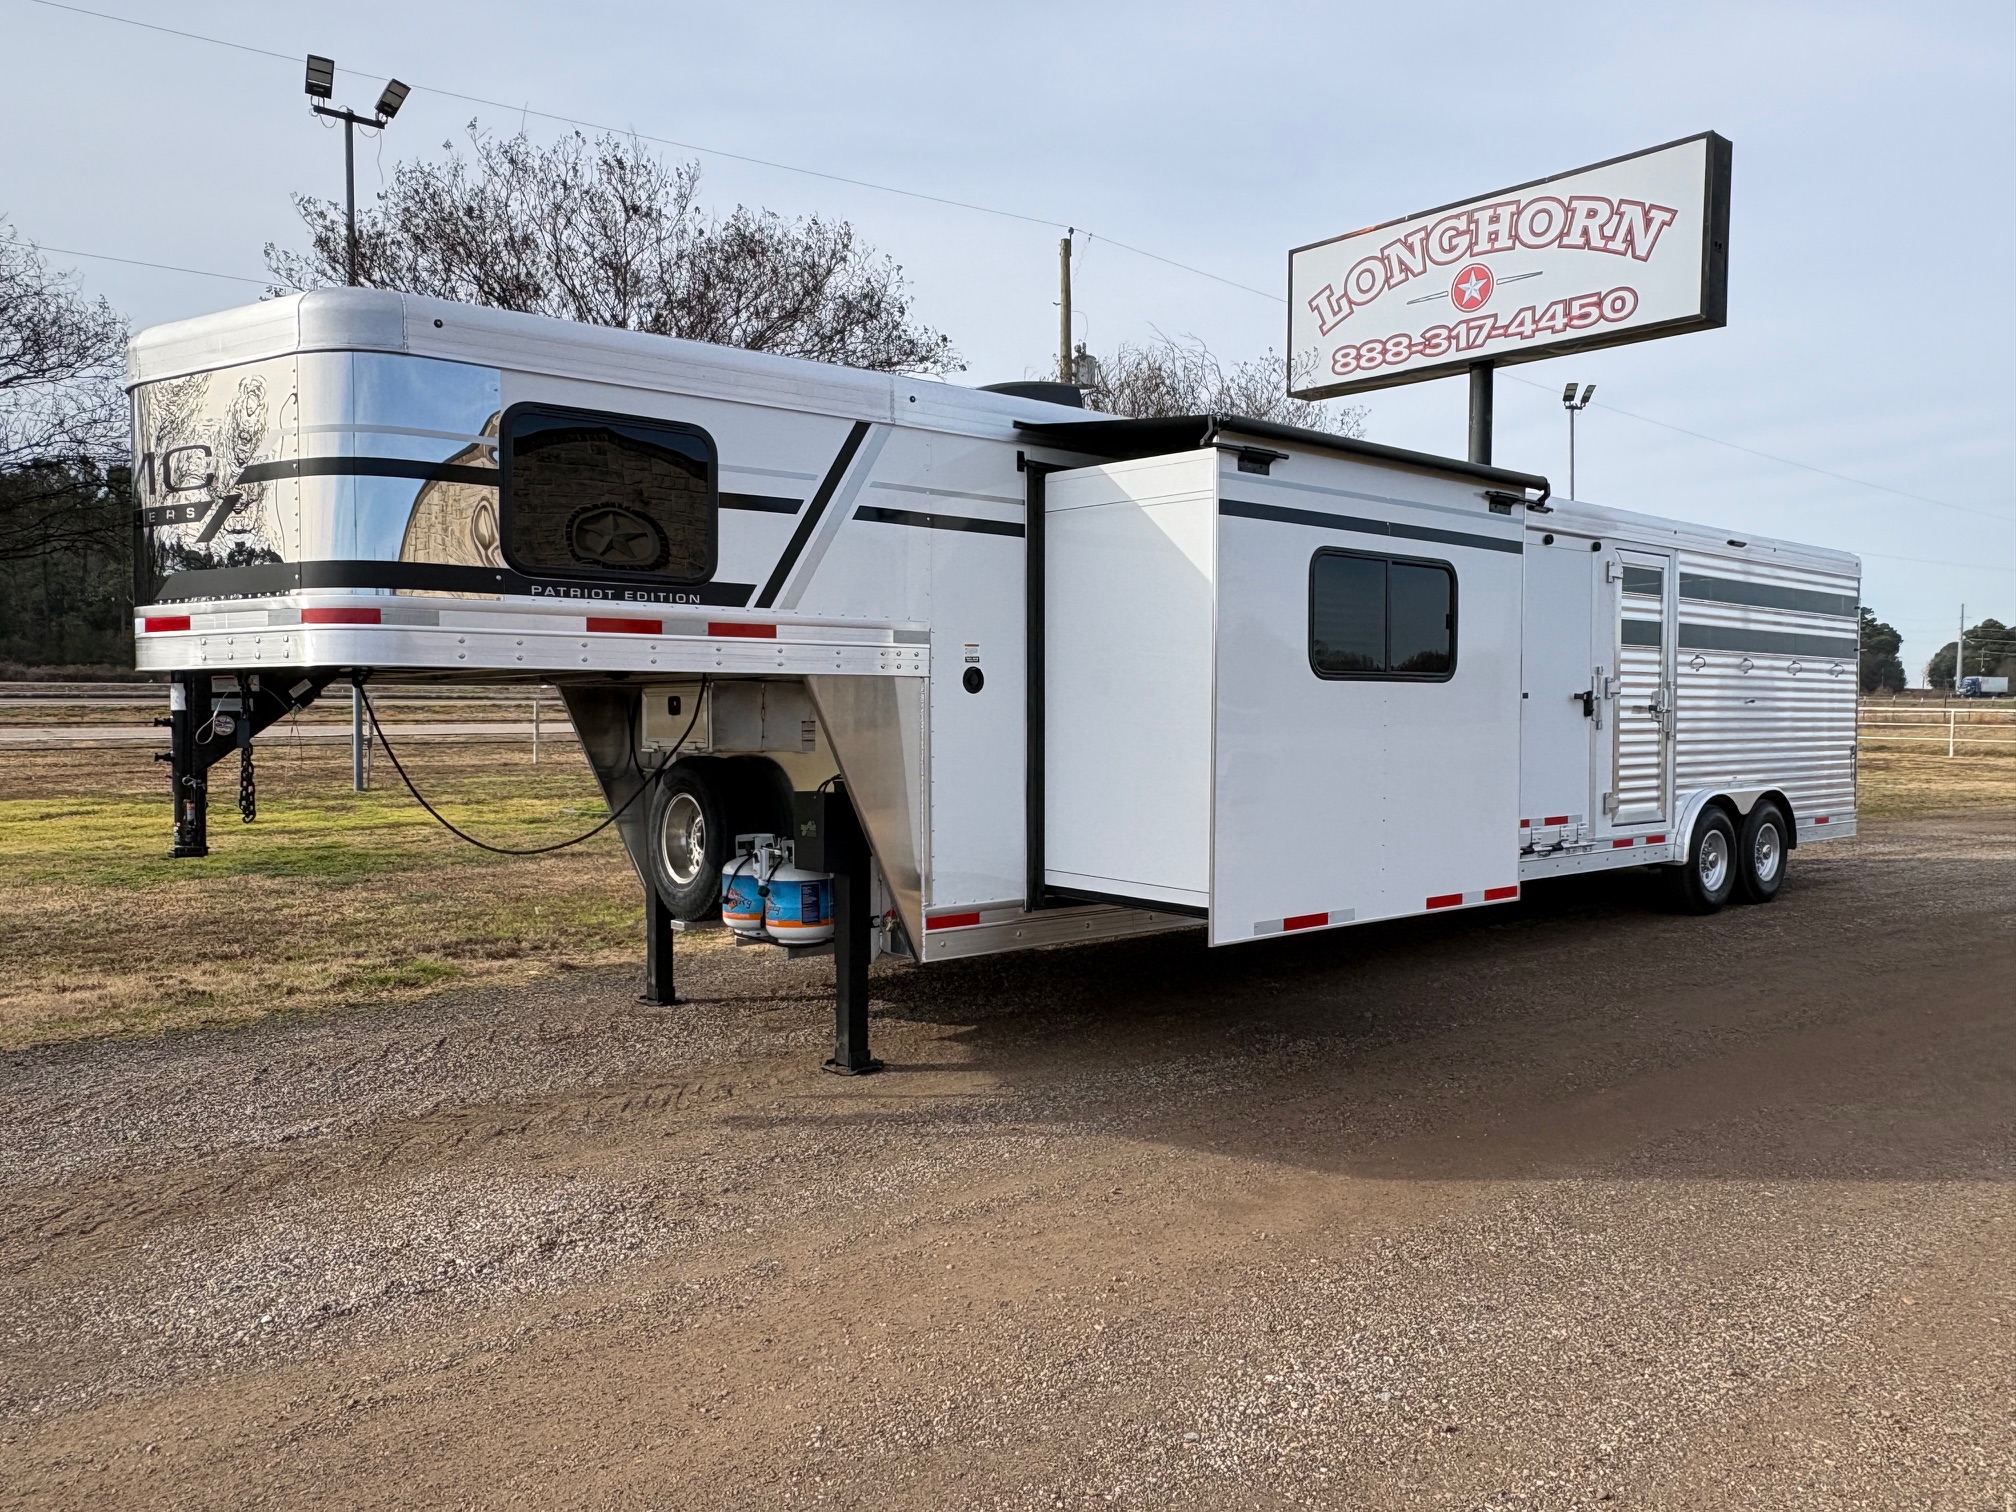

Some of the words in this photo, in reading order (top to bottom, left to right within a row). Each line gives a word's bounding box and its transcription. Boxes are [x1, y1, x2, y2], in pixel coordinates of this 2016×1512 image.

[1309, 195, 1678, 336] LONGHORN
[1331, 286, 1639, 376] 888-317-4450
[531, 585, 615, 600] PATRIOT
[624, 591, 700, 604] EDITION
